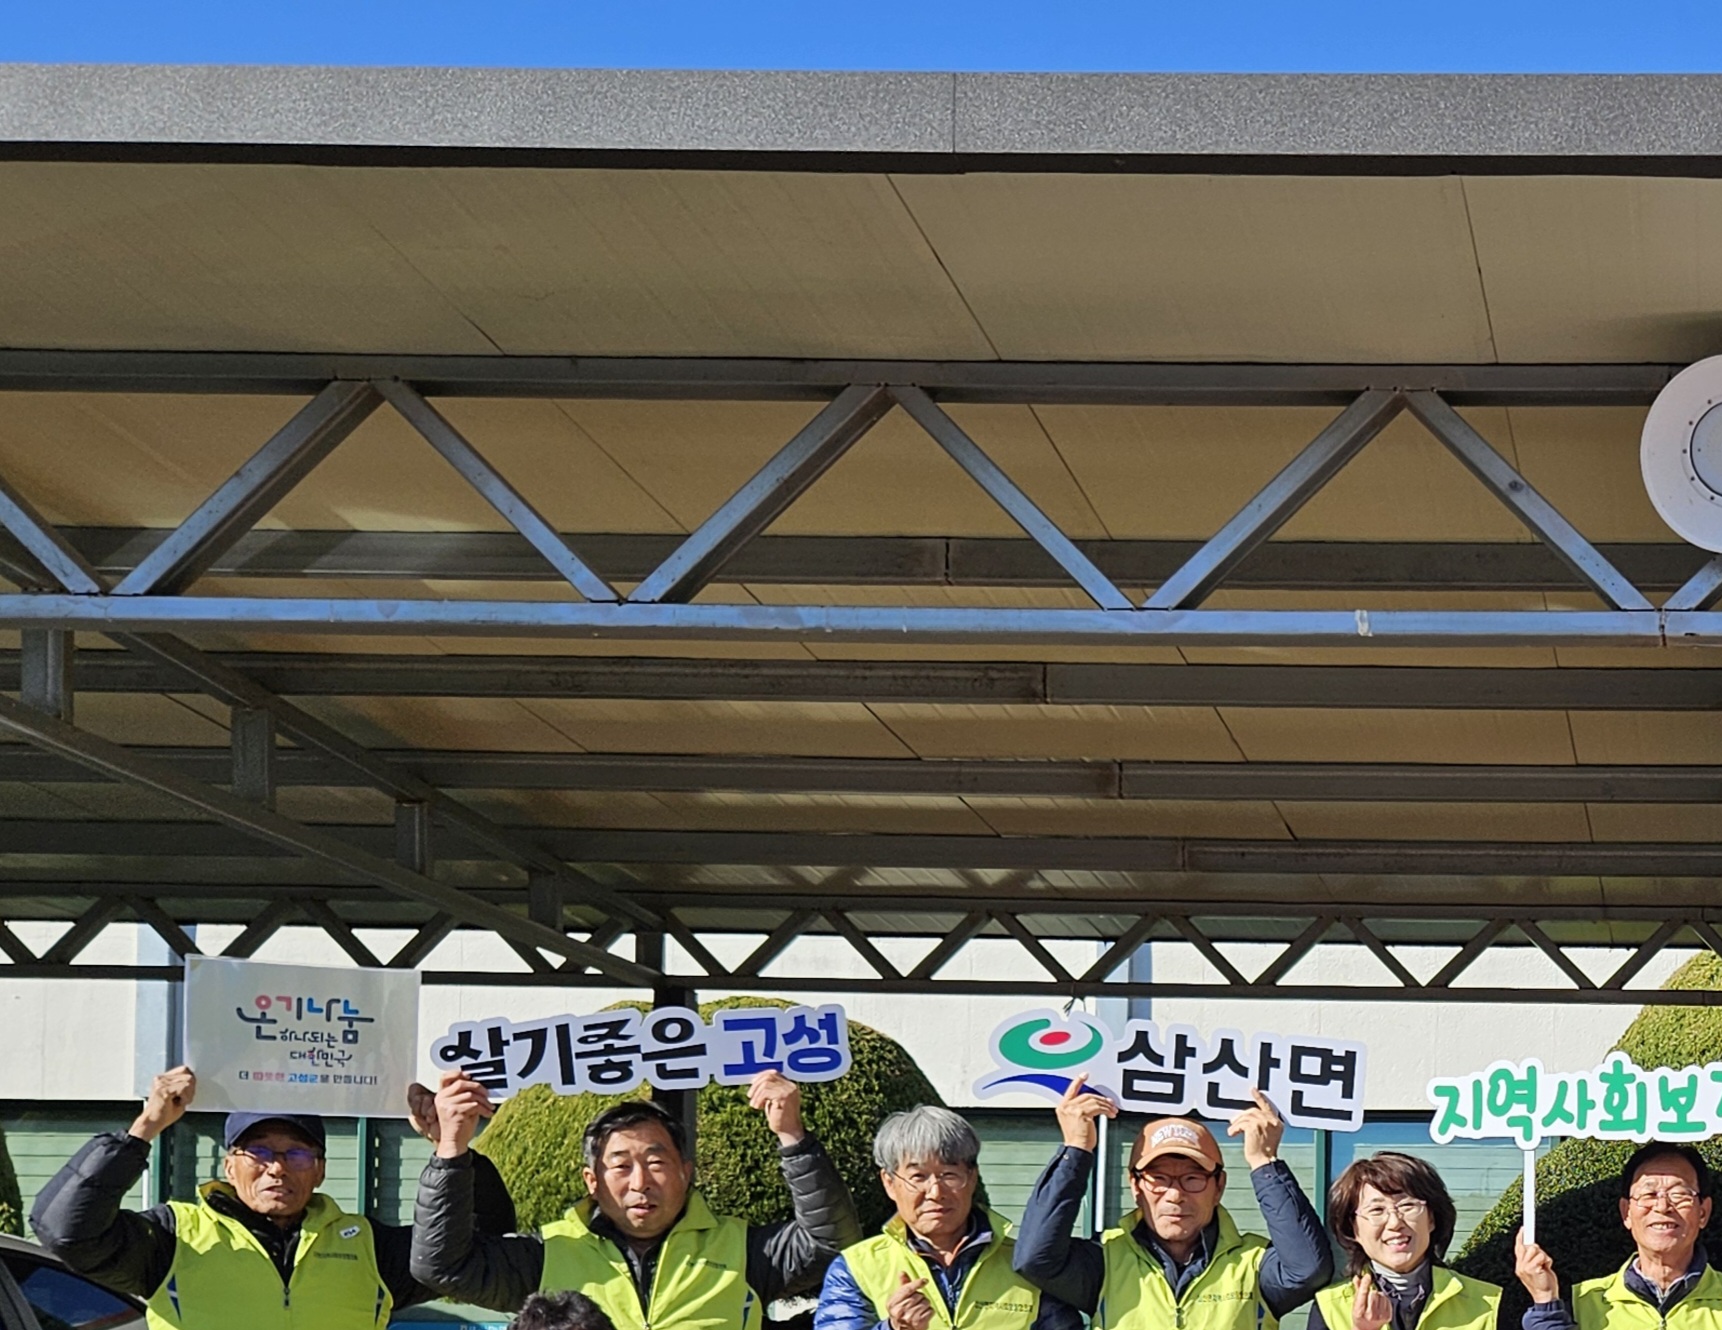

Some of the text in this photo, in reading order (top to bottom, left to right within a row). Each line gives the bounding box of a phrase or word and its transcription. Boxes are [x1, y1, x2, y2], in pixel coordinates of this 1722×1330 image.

[236, 995, 375, 1045] 온기나눔
[279, 1028, 339, 1049] 하나되는
[439, 1012, 842, 1089] 살기좋은 고성
[290, 1047, 353, 1068] 대한민국
[1116, 1028, 1360, 1122] 삼산면
[238, 1070, 249, 1081] 더
